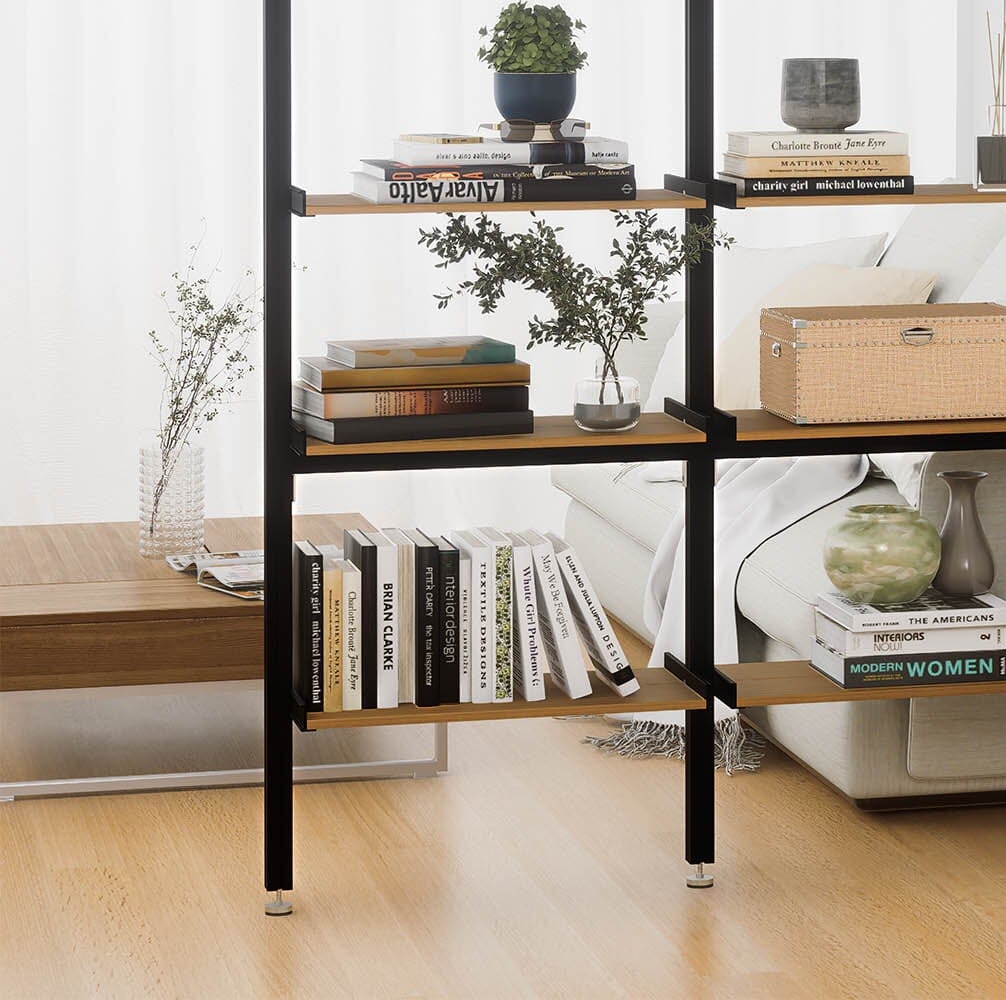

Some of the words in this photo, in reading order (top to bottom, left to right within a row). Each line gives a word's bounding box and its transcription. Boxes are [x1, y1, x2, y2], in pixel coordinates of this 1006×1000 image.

[771, 140, 812, 151] Charlotte
[843, 138, 867, 151] Jane
[867, 138, 887, 150] Eyre
[389, 181, 443, 204] Aalto
[447, 181, 498, 203] Alvar
[752, 181, 790, 193] charity
[790, 181, 809, 192] girl
[815, 179, 855, 191] michael
[856, 178, 905, 189] lowenthal
[541, 553, 553, 573] May
[310, 562, 321, 595] charity
[425, 567, 435, 590] PETER
[522, 566, 532, 602] White
[547, 573, 558, 589] We
[310, 596, 321, 614] girl
[383, 583, 394, 622] BRIAN
[425, 592, 435, 617] CAREY
[551, 588, 561, 602] Be
[574, 571, 585, 590] AND
[580, 589, 592, 608] JULIA
[589, 606, 605, 632] LUPTON
[347, 591, 357, 624] Charlotte
[525, 603, 535, 628] Girl
[554, 602, 570, 640] Forgiven
[908, 617, 930, 625] THE
[932, 614, 995, 624] AMERICANS
[310, 620, 321, 657] michael
[424, 625, 434, 637] the
[873, 631, 926, 643] INTERIORS
[980, 632, 991, 641] 2
[383, 625, 394, 671] CLARKE
[424, 638, 434, 651] tax
[527, 628, 540, 673] Problems
[348, 653, 358, 673] Jane
[424, 652, 434, 687] inspector
[850, 661, 904, 674] MODERN
[906, 657, 994, 678] WOMEN
[310, 658, 321, 704] lowenthal
[348, 673, 359, 690] Eyre
